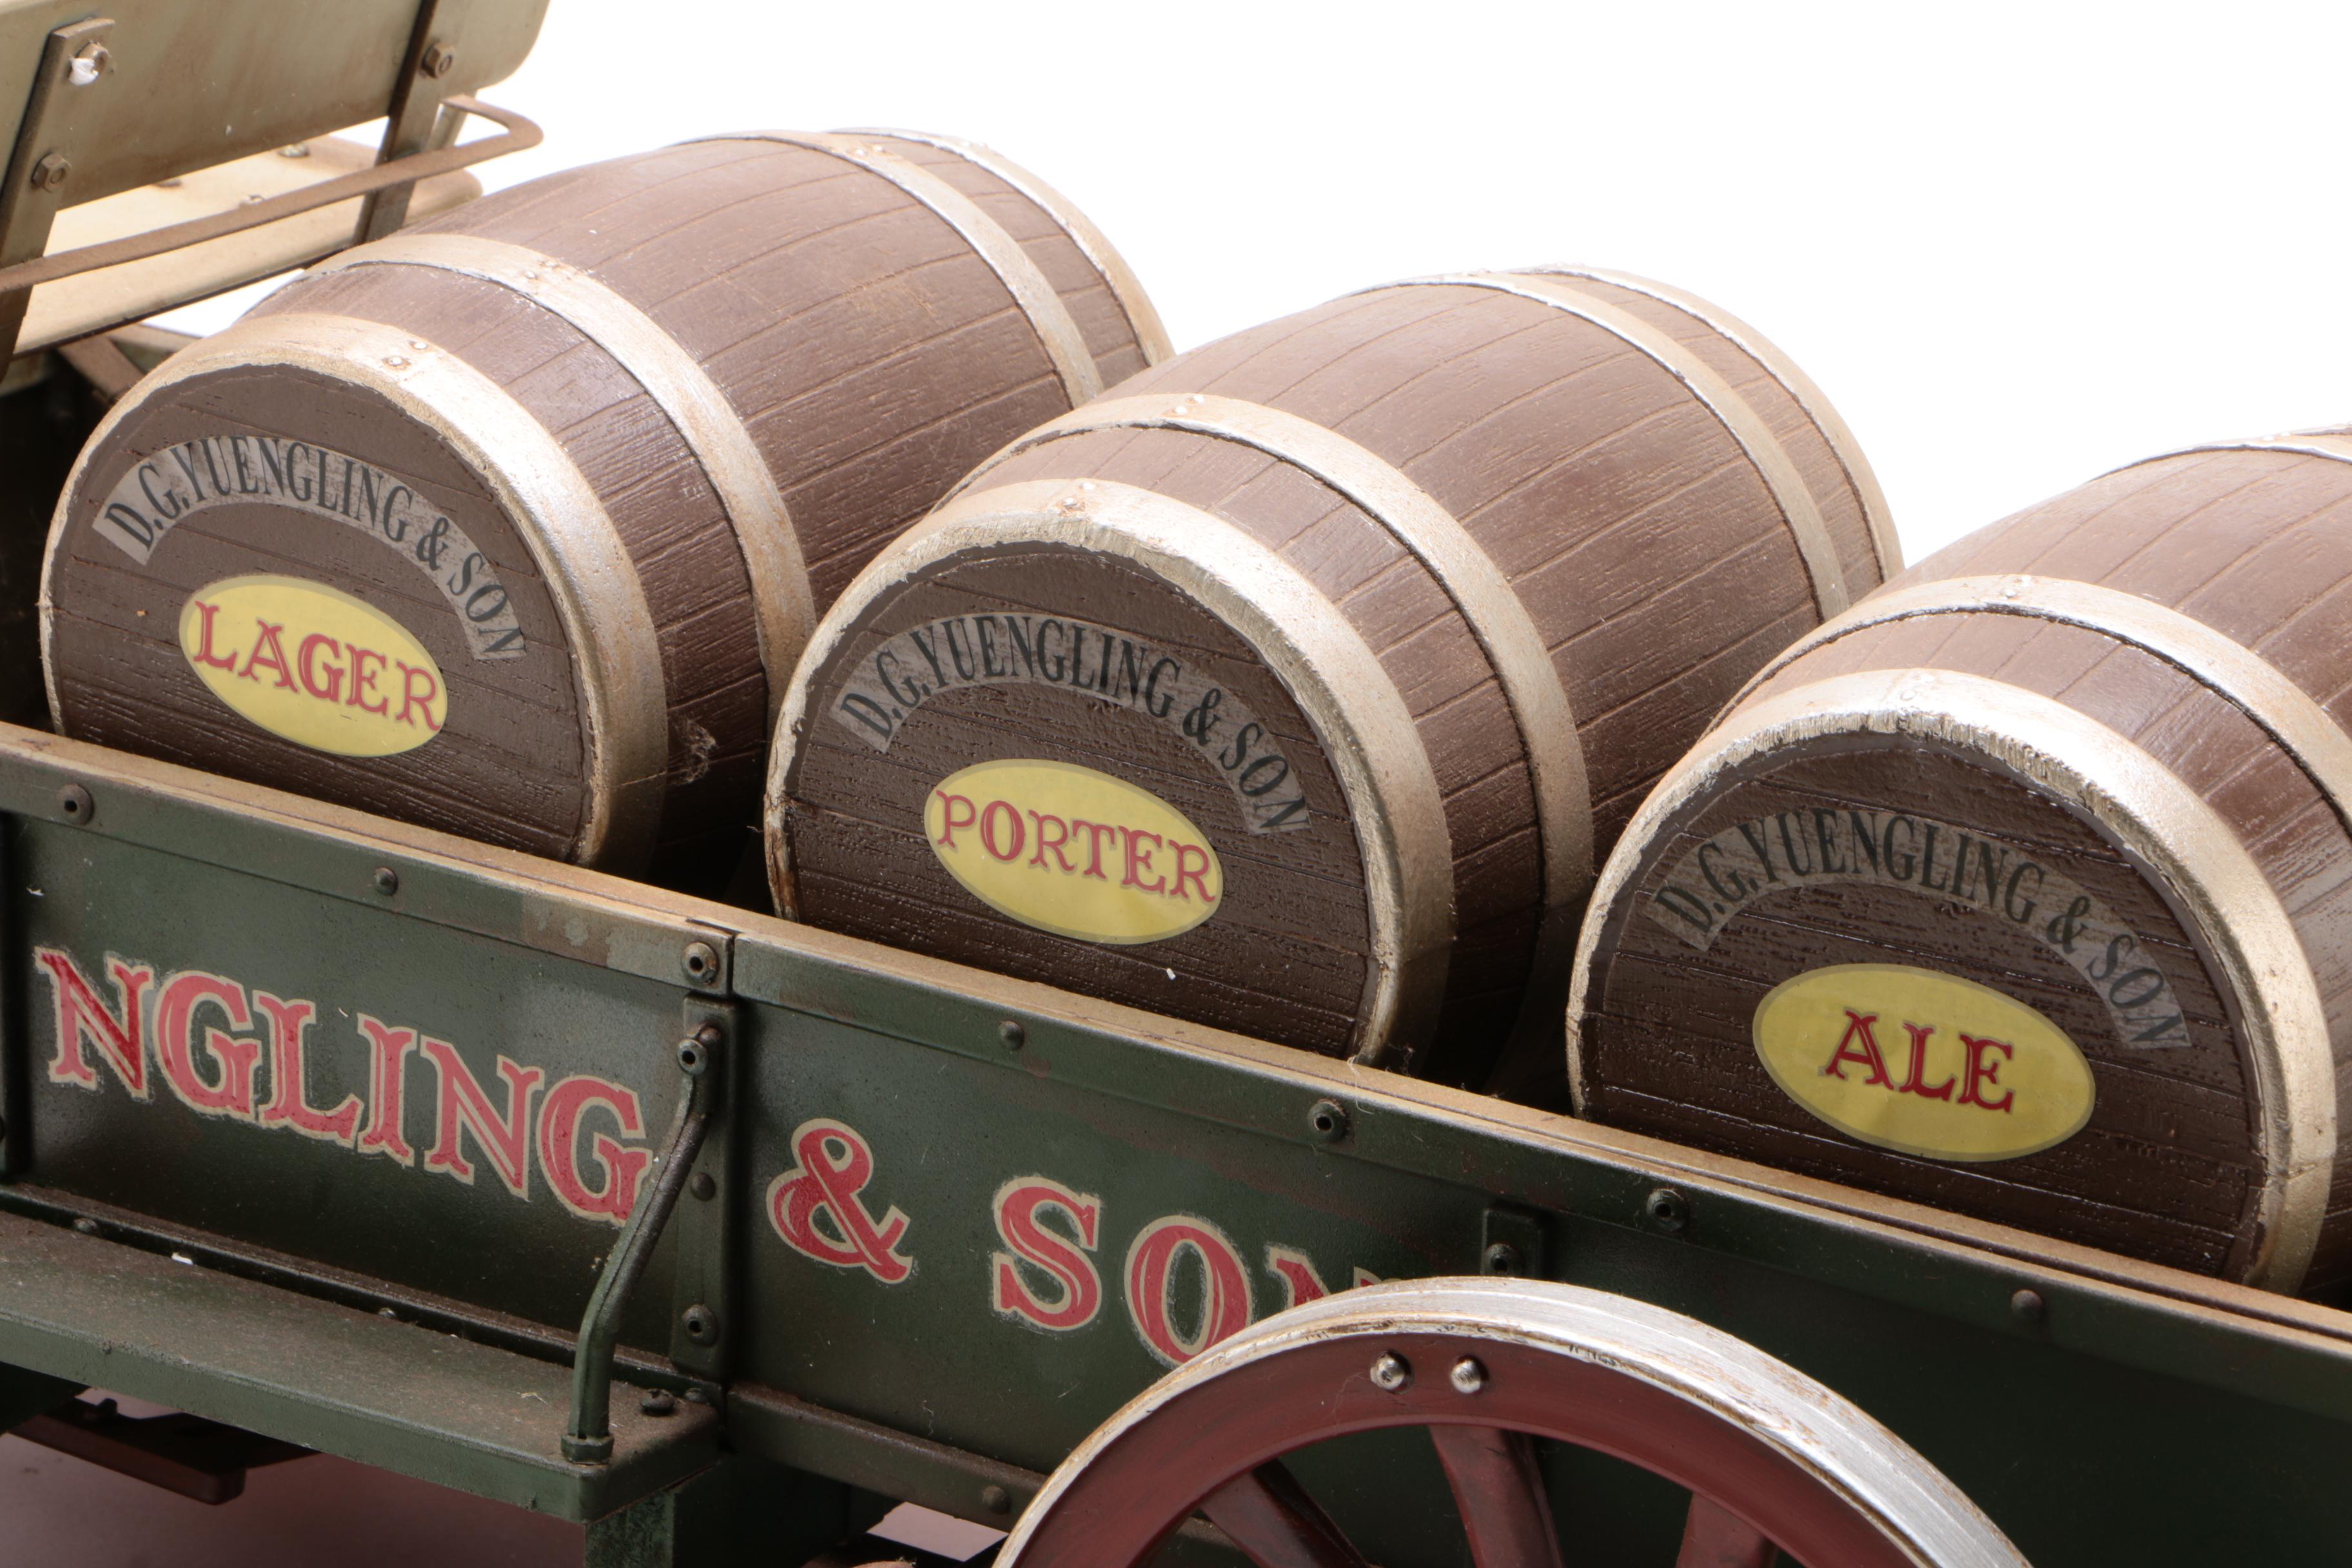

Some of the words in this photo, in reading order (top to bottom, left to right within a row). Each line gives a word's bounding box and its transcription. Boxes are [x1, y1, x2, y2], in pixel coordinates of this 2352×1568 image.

[415, 516, 451, 571] &
[449, 552, 524, 658] SON
[193, 601, 441, 732] LAGER
[1182, 687, 1222, 745] &
[1217, 722, 1310, 830] SON
[936, 790, 1215, 902] PORTER
[2046, 896, 2092, 955] &
[2086, 932, 2190, 1046] SON
[1823, 1010, 2014, 1113] ALE
[767, 1117, 914, 1284] &
